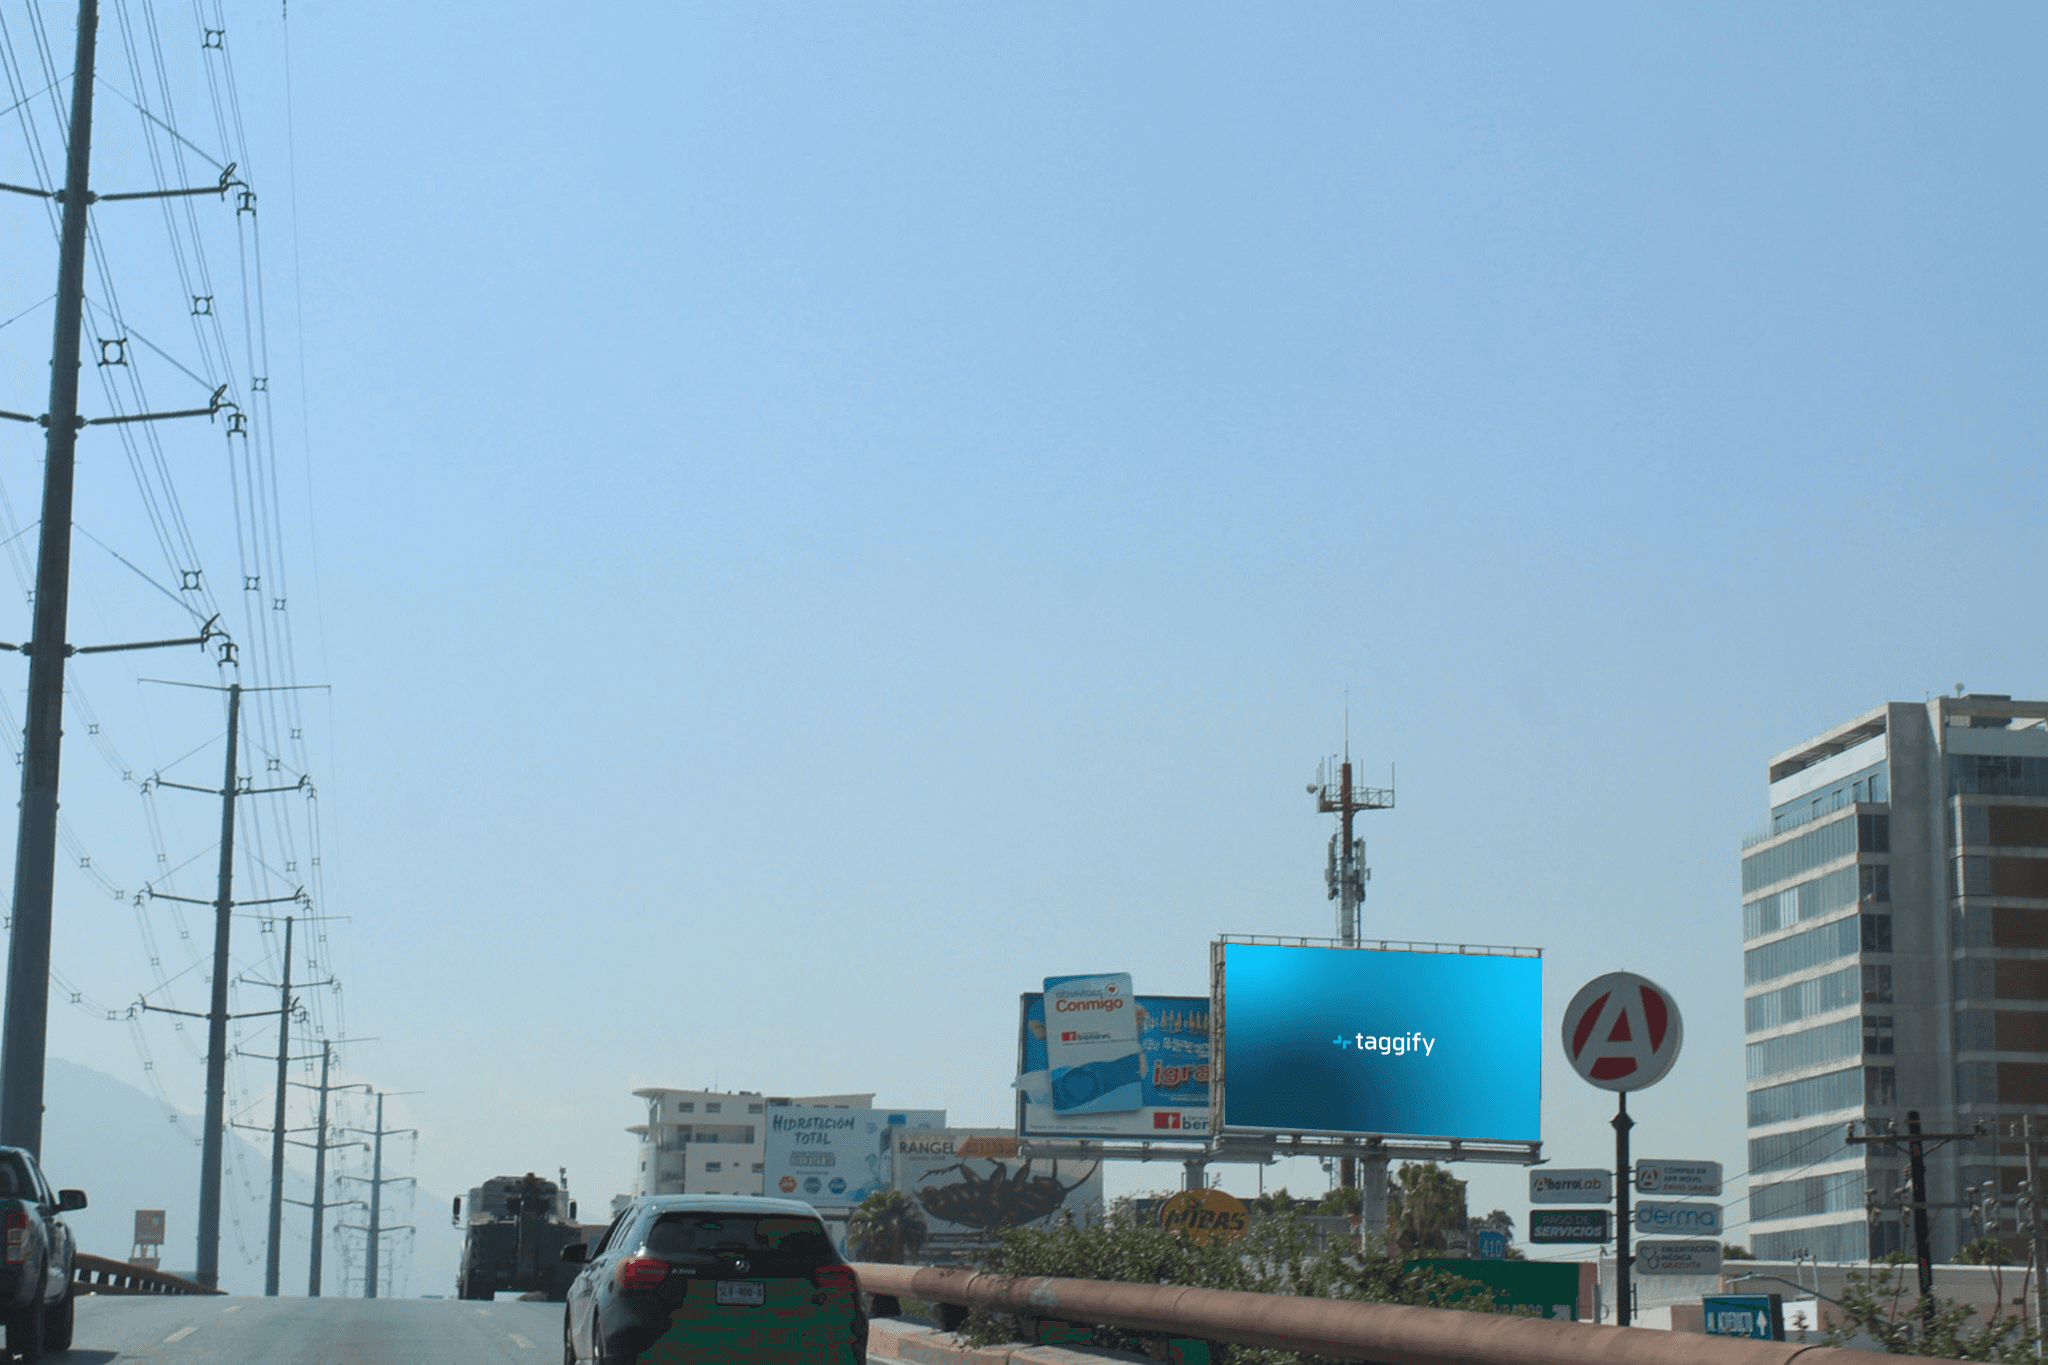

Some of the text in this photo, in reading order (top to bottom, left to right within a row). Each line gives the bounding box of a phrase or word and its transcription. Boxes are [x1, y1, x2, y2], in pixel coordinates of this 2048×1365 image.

[1055, 997, 1123, 1013] Conmigo
[1355, 1032, 1436, 1056] taggify
[794, 1131, 831, 1145] TOTAL
[899, 1141, 956, 1154] RANGEL
[1165, 1209, 1246, 1232] MIDAS
[1542, 1215, 1589, 1225] PAGO DE
[1637, 1205, 1714, 1226] derma
[1534, 1226, 1603, 1237] SERVICIOS
